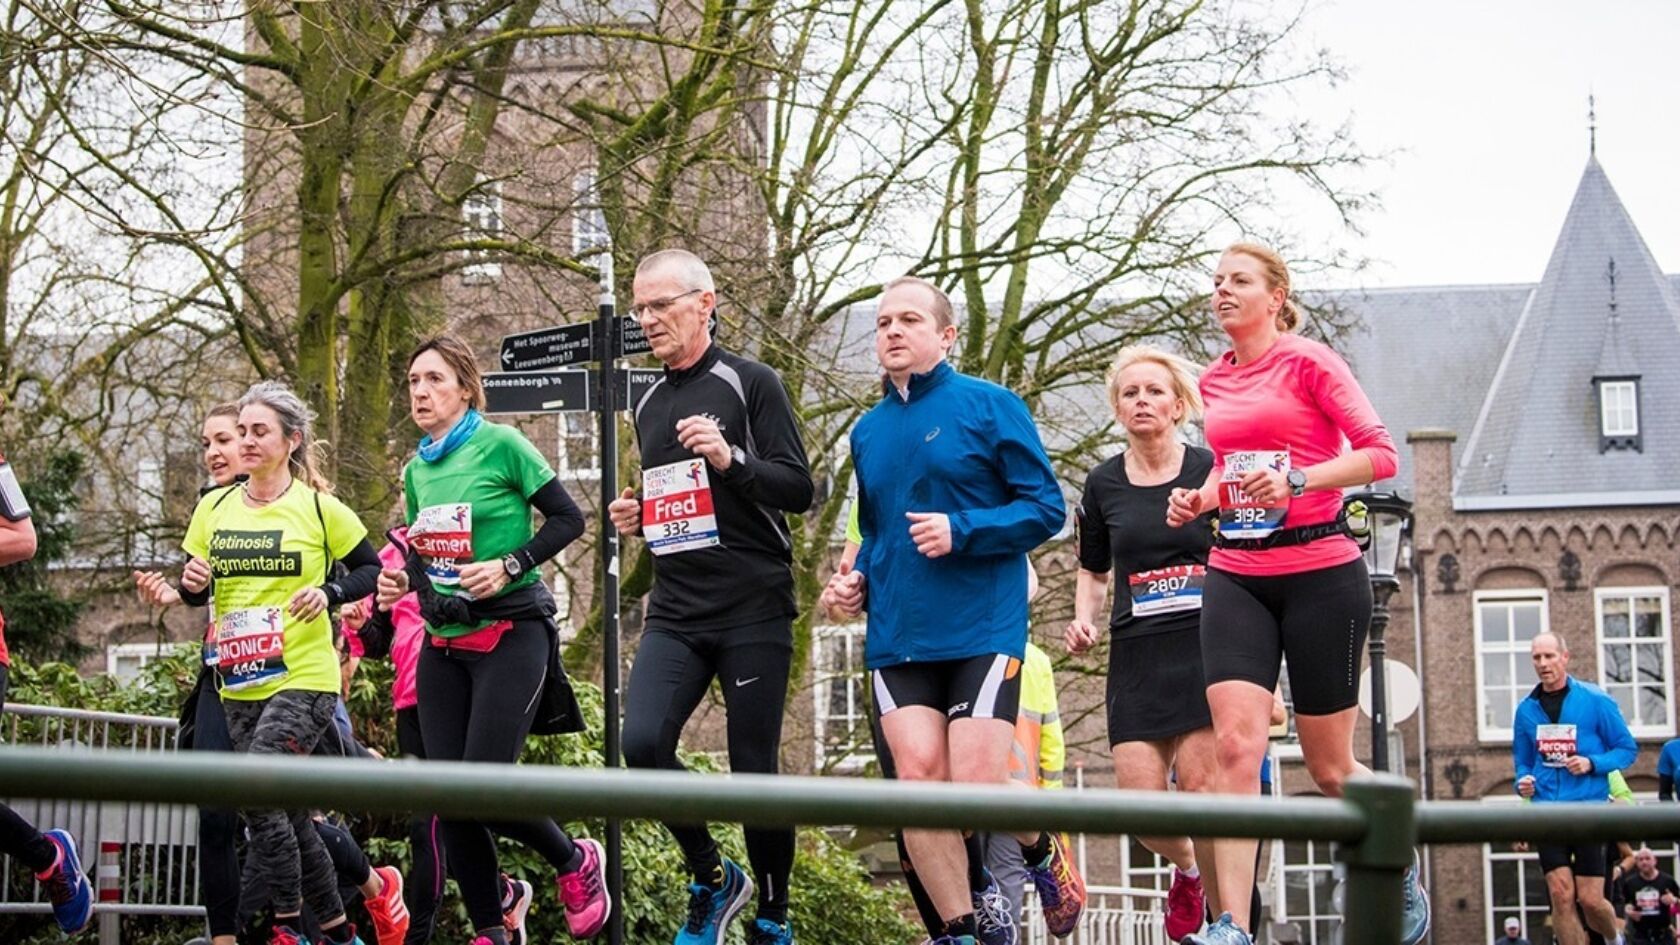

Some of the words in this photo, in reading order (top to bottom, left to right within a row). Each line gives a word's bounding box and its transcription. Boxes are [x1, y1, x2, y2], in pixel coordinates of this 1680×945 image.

[514, 339, 528, 349] Het
[529, 332, 569, 347] Spoorweg-
[548, 340, 580, 353] museum
[514, 353, 563, 369] Leeuwenberg
[482, 376, 549, 388] Sonnenborgh
[632, 374, 656, 384] INFO
[654, 492, 697, 521] Fred
[1234, 507, 1266, 523] 3192
[663, 520, 690, 538] 332
[411, 537, 472, 553] Carmen
[210, 554, 296, 576] Pigmentaria
[1148, 576, 1189, 594] 2807
[219, 635, 283, 661] MONICA
[232, 658, 266, 676] 4447
[1538, 740, 1576, 752] Jeroen
